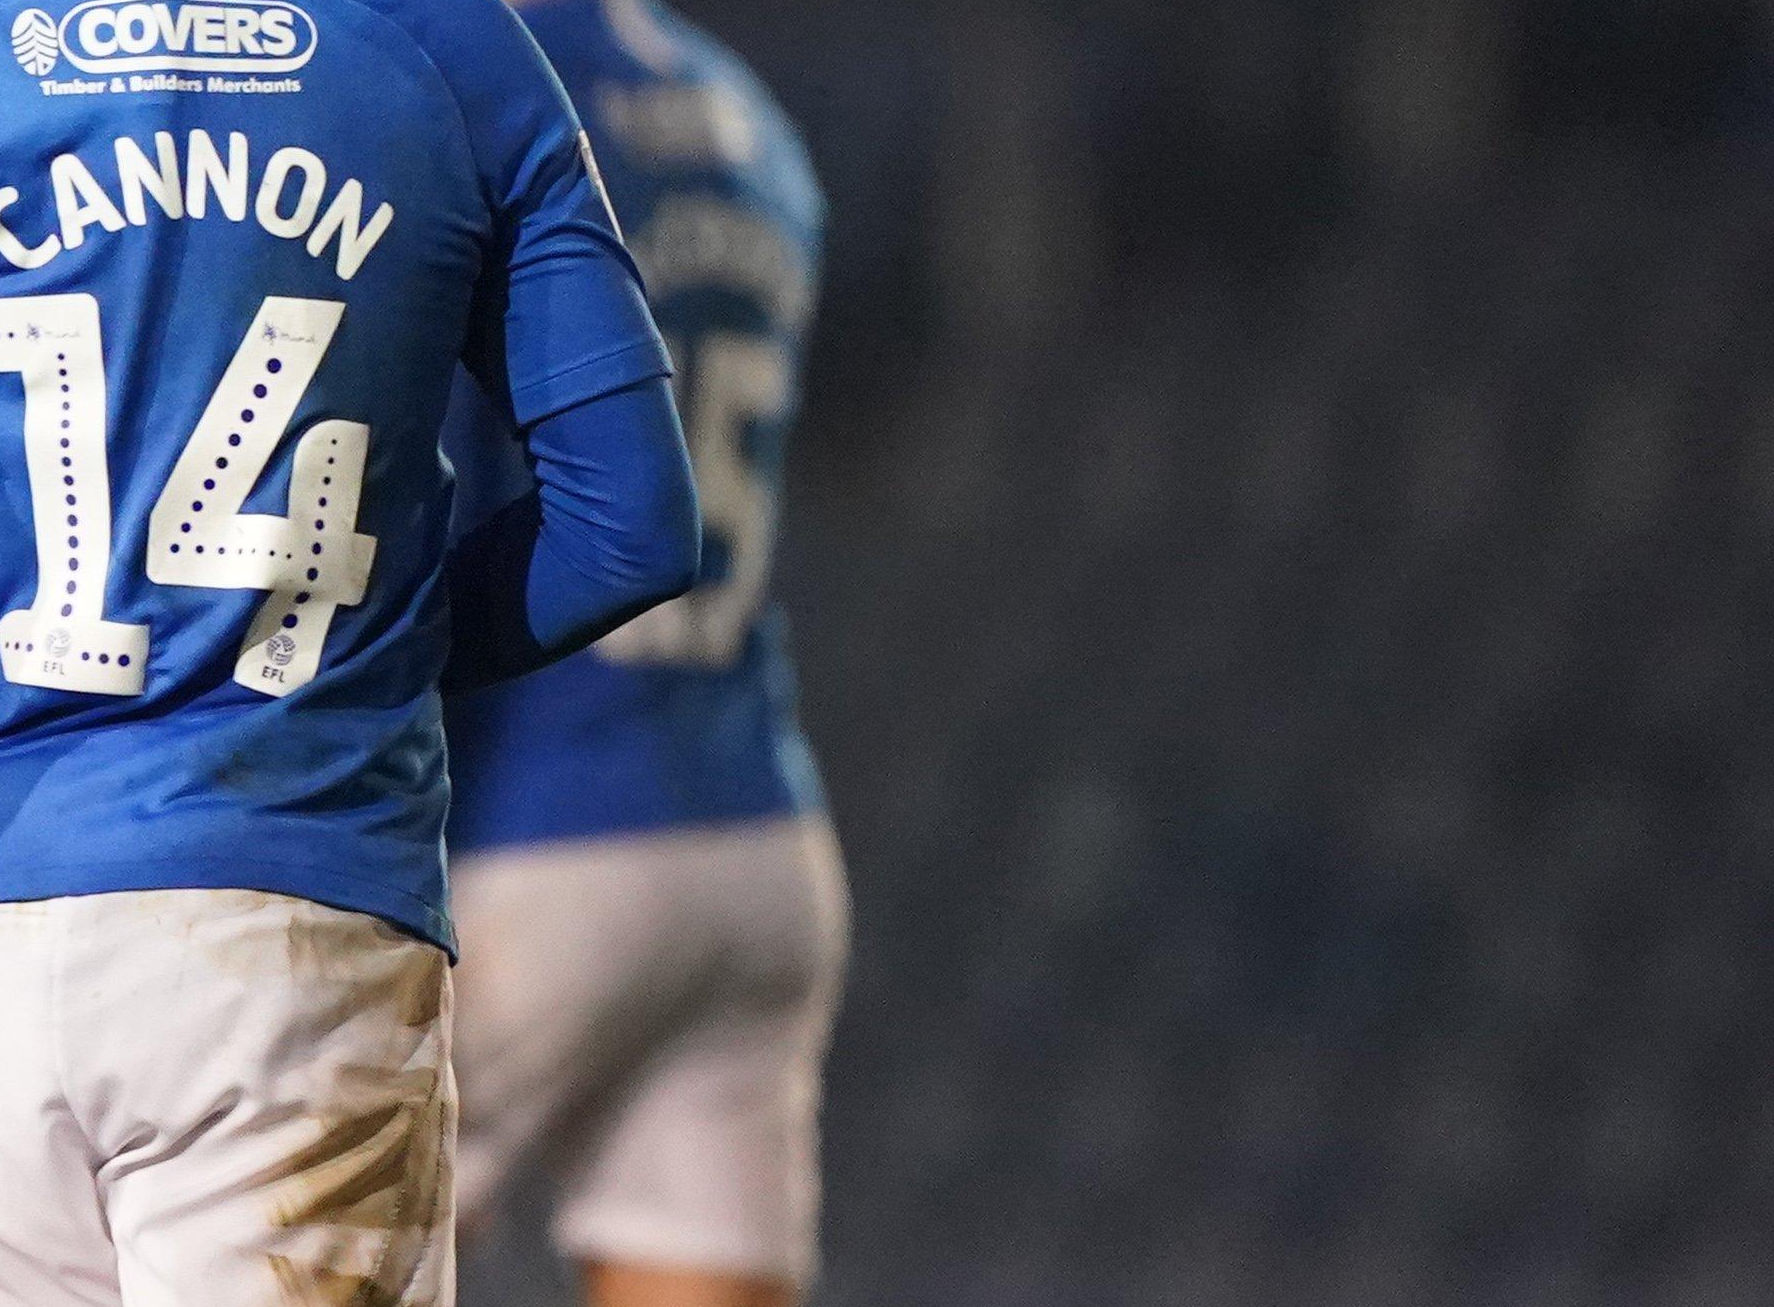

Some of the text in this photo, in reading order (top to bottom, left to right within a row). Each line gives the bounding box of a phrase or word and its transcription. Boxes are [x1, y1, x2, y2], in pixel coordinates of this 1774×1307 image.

[77, 3, 298, 56] COVERS
[40, 75, 302, 96] Timber & Builders Merchants
[43, 660, 66, 676] EFL
[261, 665, 287, 684] EFL
